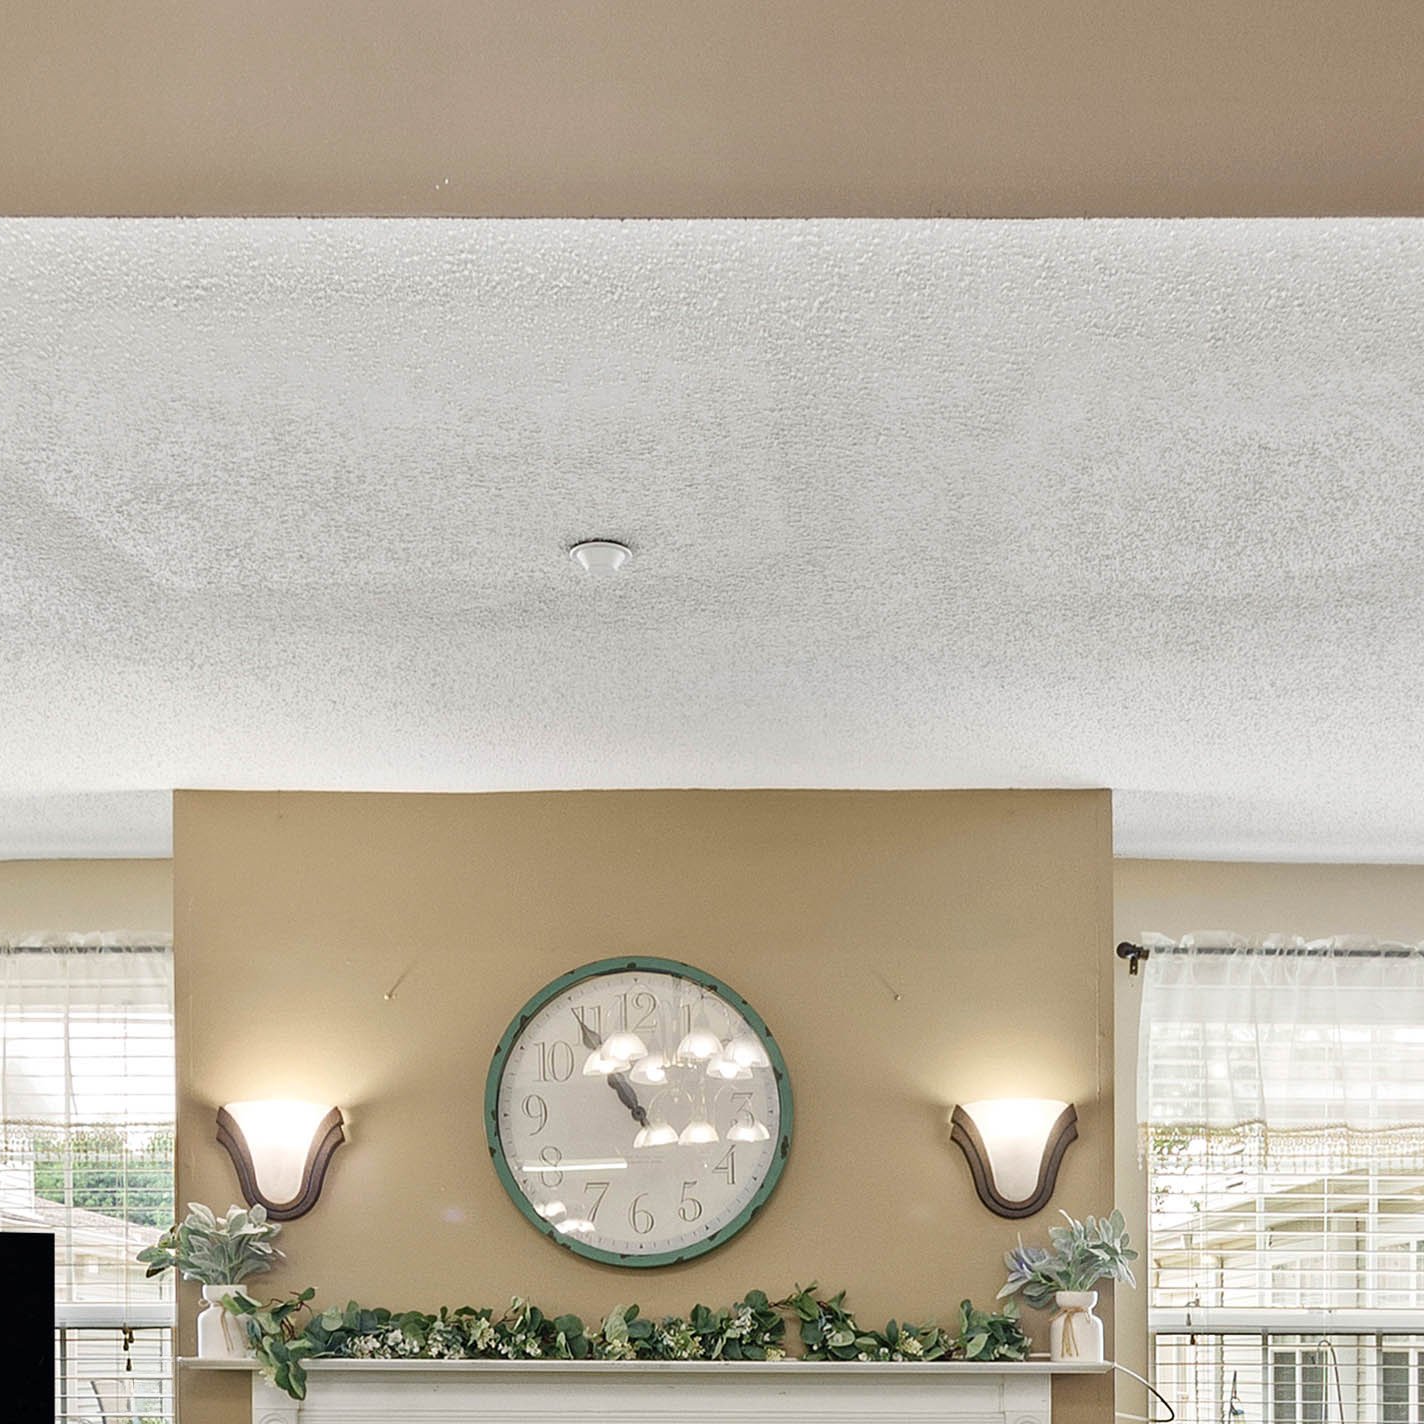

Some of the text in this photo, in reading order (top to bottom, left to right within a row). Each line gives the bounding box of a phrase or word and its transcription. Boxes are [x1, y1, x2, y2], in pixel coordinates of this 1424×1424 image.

[615, 991, 657, 1033] 12
[533, 1040, 575, 1083] 10
[521, 1094, 548, 1136] 9
[538, 1146, 564, 1188] 8
[712, 1143, 737, 1185] 4
[583, 1181, 610, 1223] 7
[628, 1192, 655, 1235] 6
[678, 1179, 703, 1222] 5
